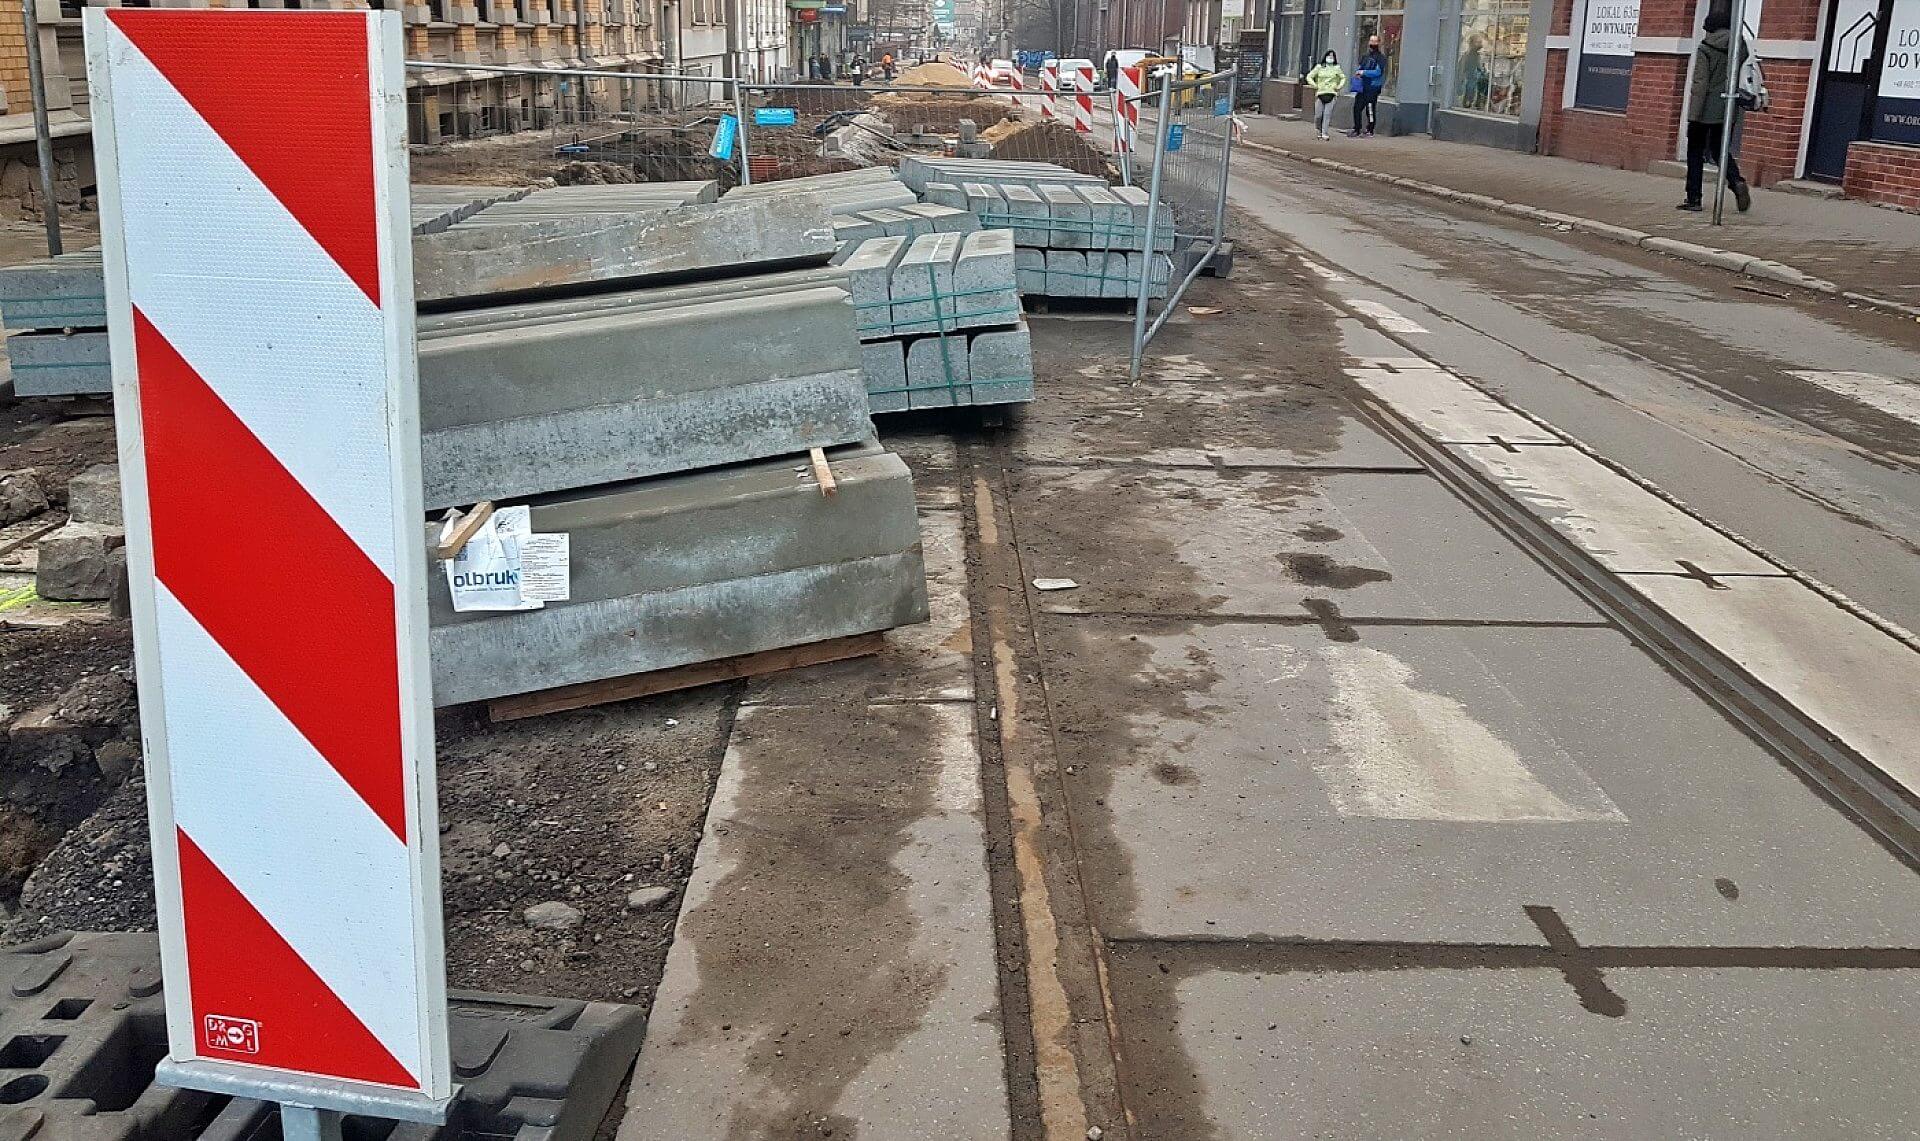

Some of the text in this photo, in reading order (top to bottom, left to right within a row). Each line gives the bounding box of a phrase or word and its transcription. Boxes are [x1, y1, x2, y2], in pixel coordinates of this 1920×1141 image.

[1596, 6, 1620, 18] LOKAL
[1591, 22, 1603, 34] DO
[1888, 52, 1909, 68] DO
